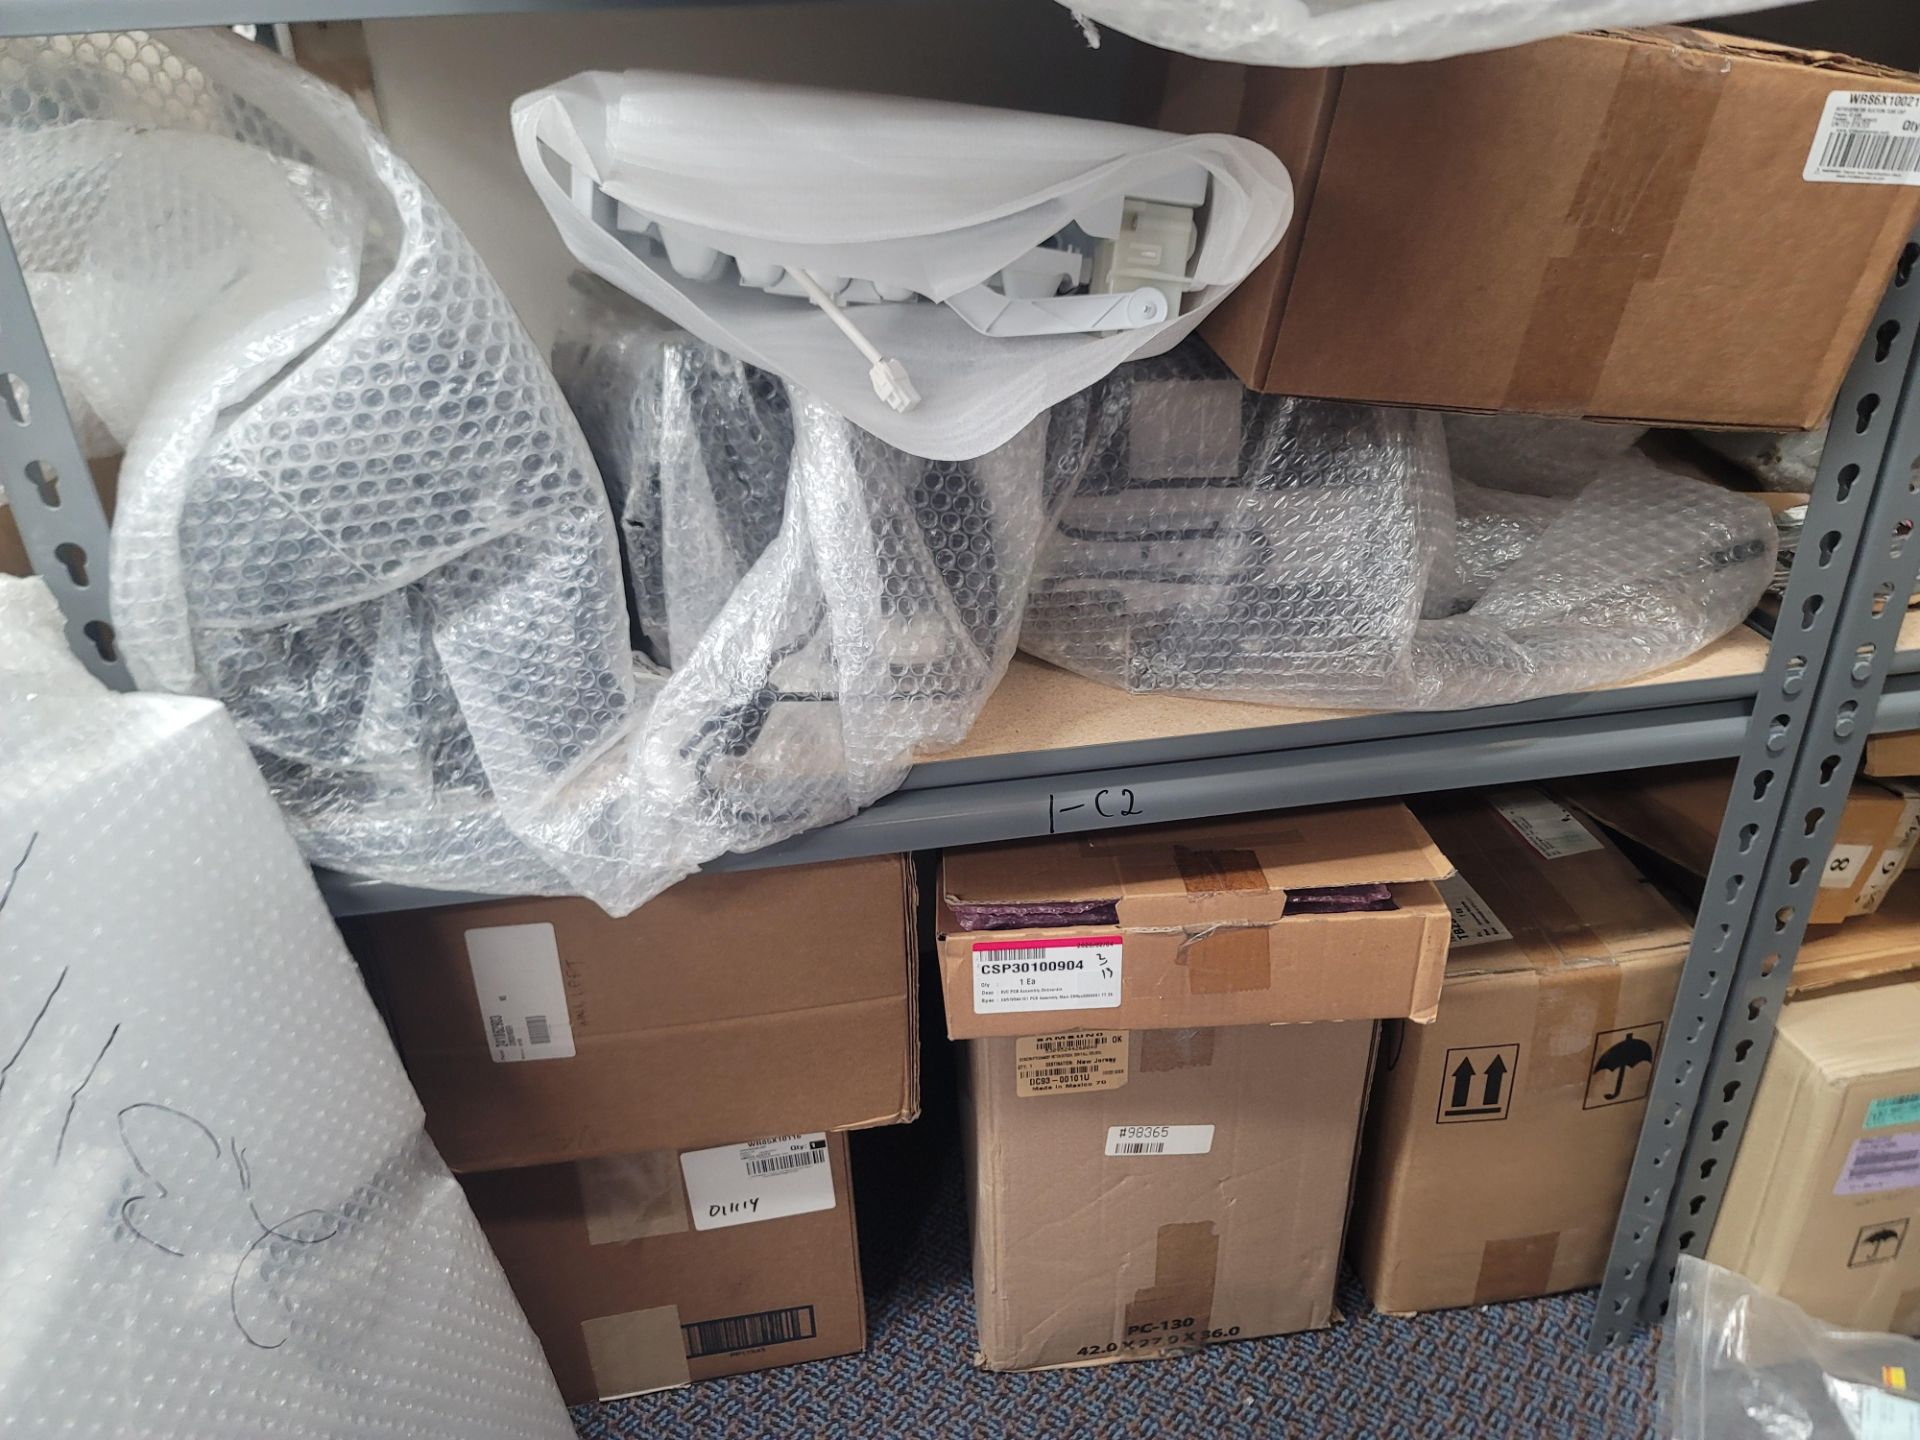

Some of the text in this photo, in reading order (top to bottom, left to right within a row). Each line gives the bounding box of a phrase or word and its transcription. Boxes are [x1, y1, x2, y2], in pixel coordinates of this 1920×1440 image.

[981, 959, 1085, 976] CSP30100904
[1026, 977, 1036, 985] Ea
[1030, 1074, 1090, 1085] DC93-00101U
[1119, 1126, 1170, 1139] #98365
[1127, 1317, 1195, 1335] PC-130
[1076, 1343, 1118, 1356] 42.0
[1138, 1335, 1178, 1348] 270
